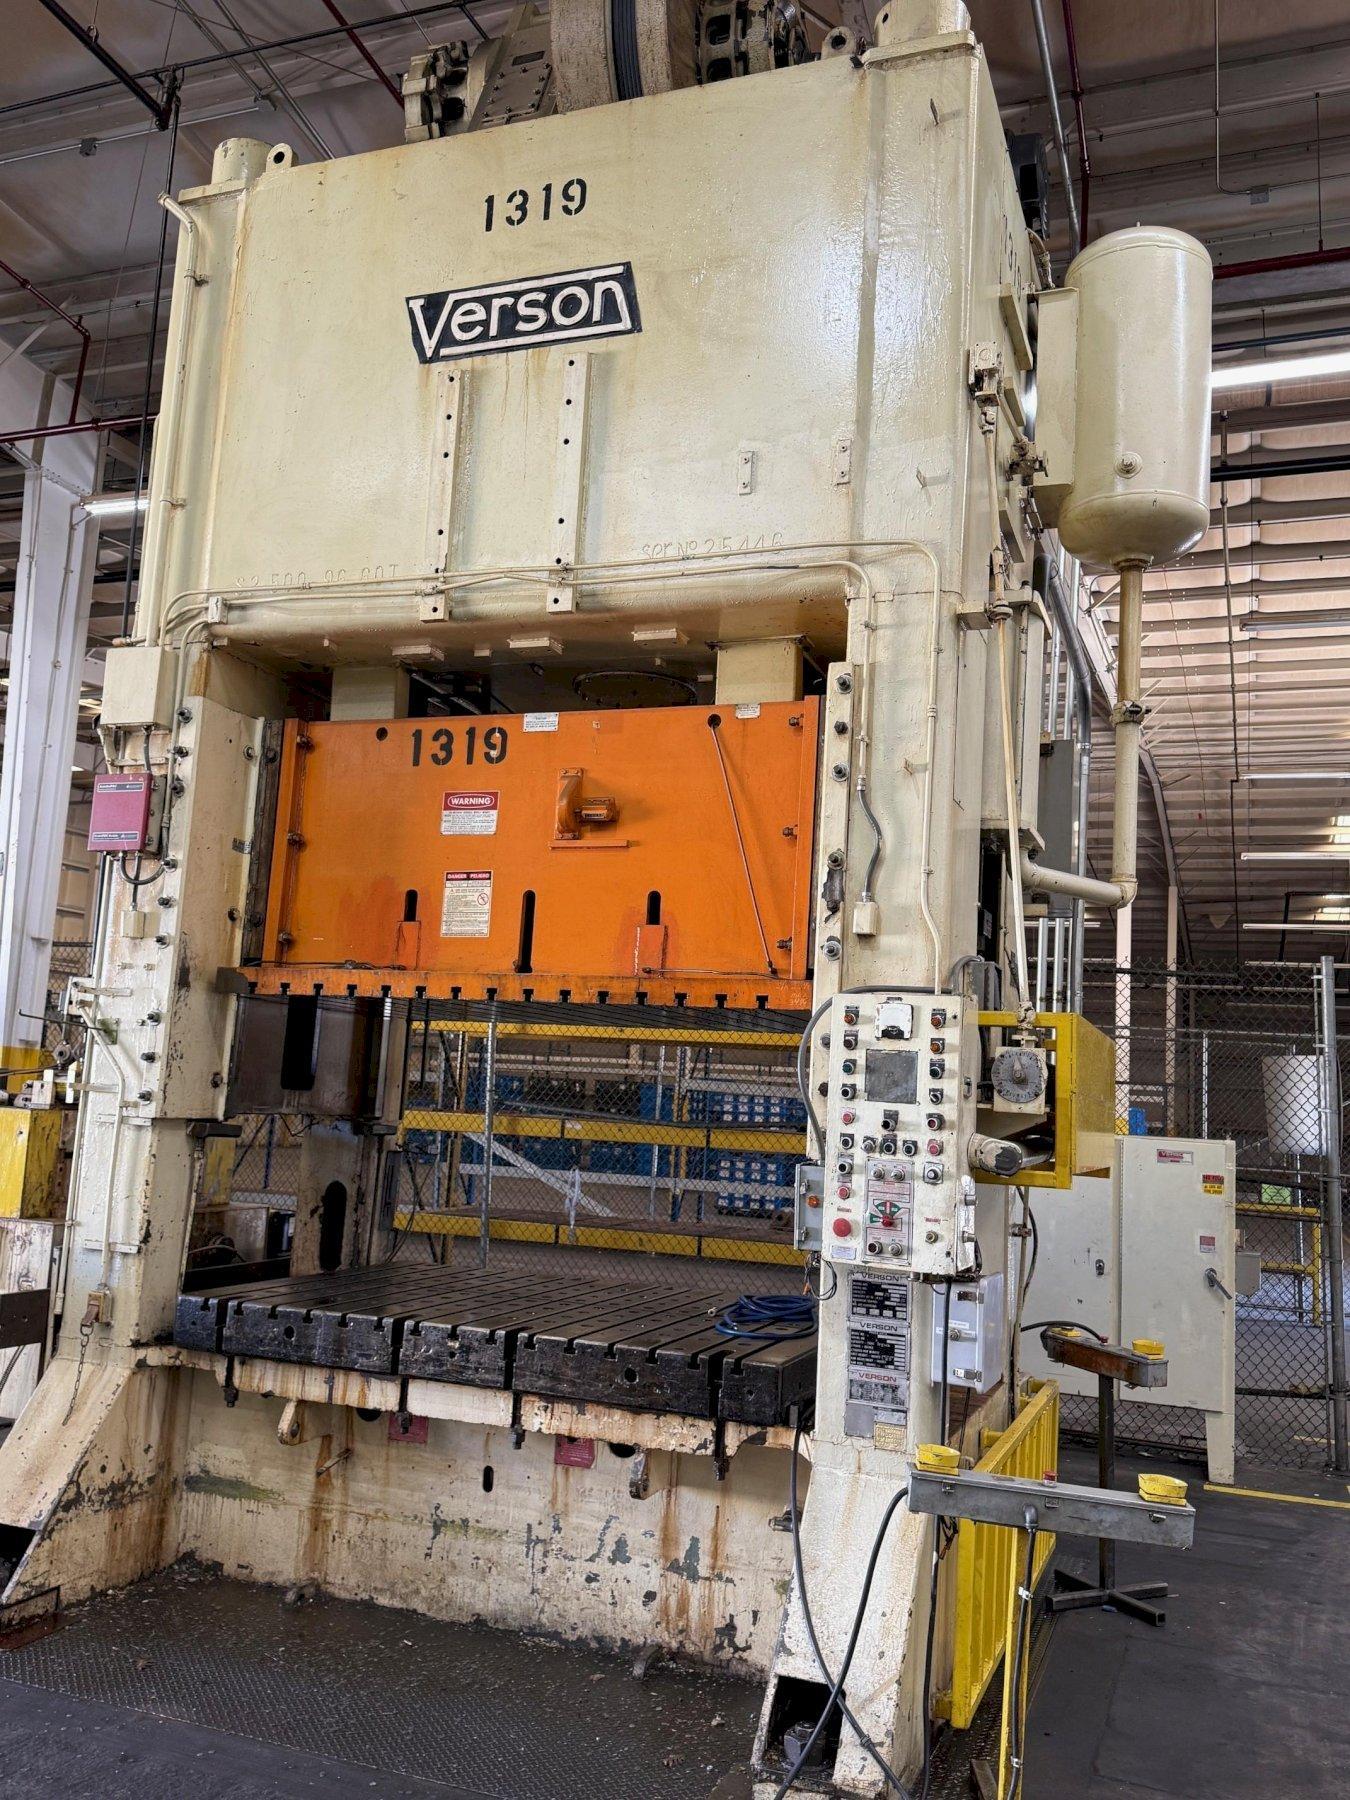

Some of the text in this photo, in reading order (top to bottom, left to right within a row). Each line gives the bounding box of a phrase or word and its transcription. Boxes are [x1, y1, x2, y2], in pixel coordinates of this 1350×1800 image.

[484, 177, 588, 233] 1319
[408, 266, 631, 359] Verson
[411, 725, 508, 768] 1319
[451, 796, 492, 806] WARNING
[861, 1271, 900, 1283] VERSON
[859, 1321, 898, 1333] VERSON
[858, 1371, 897, 1384] VERSON
